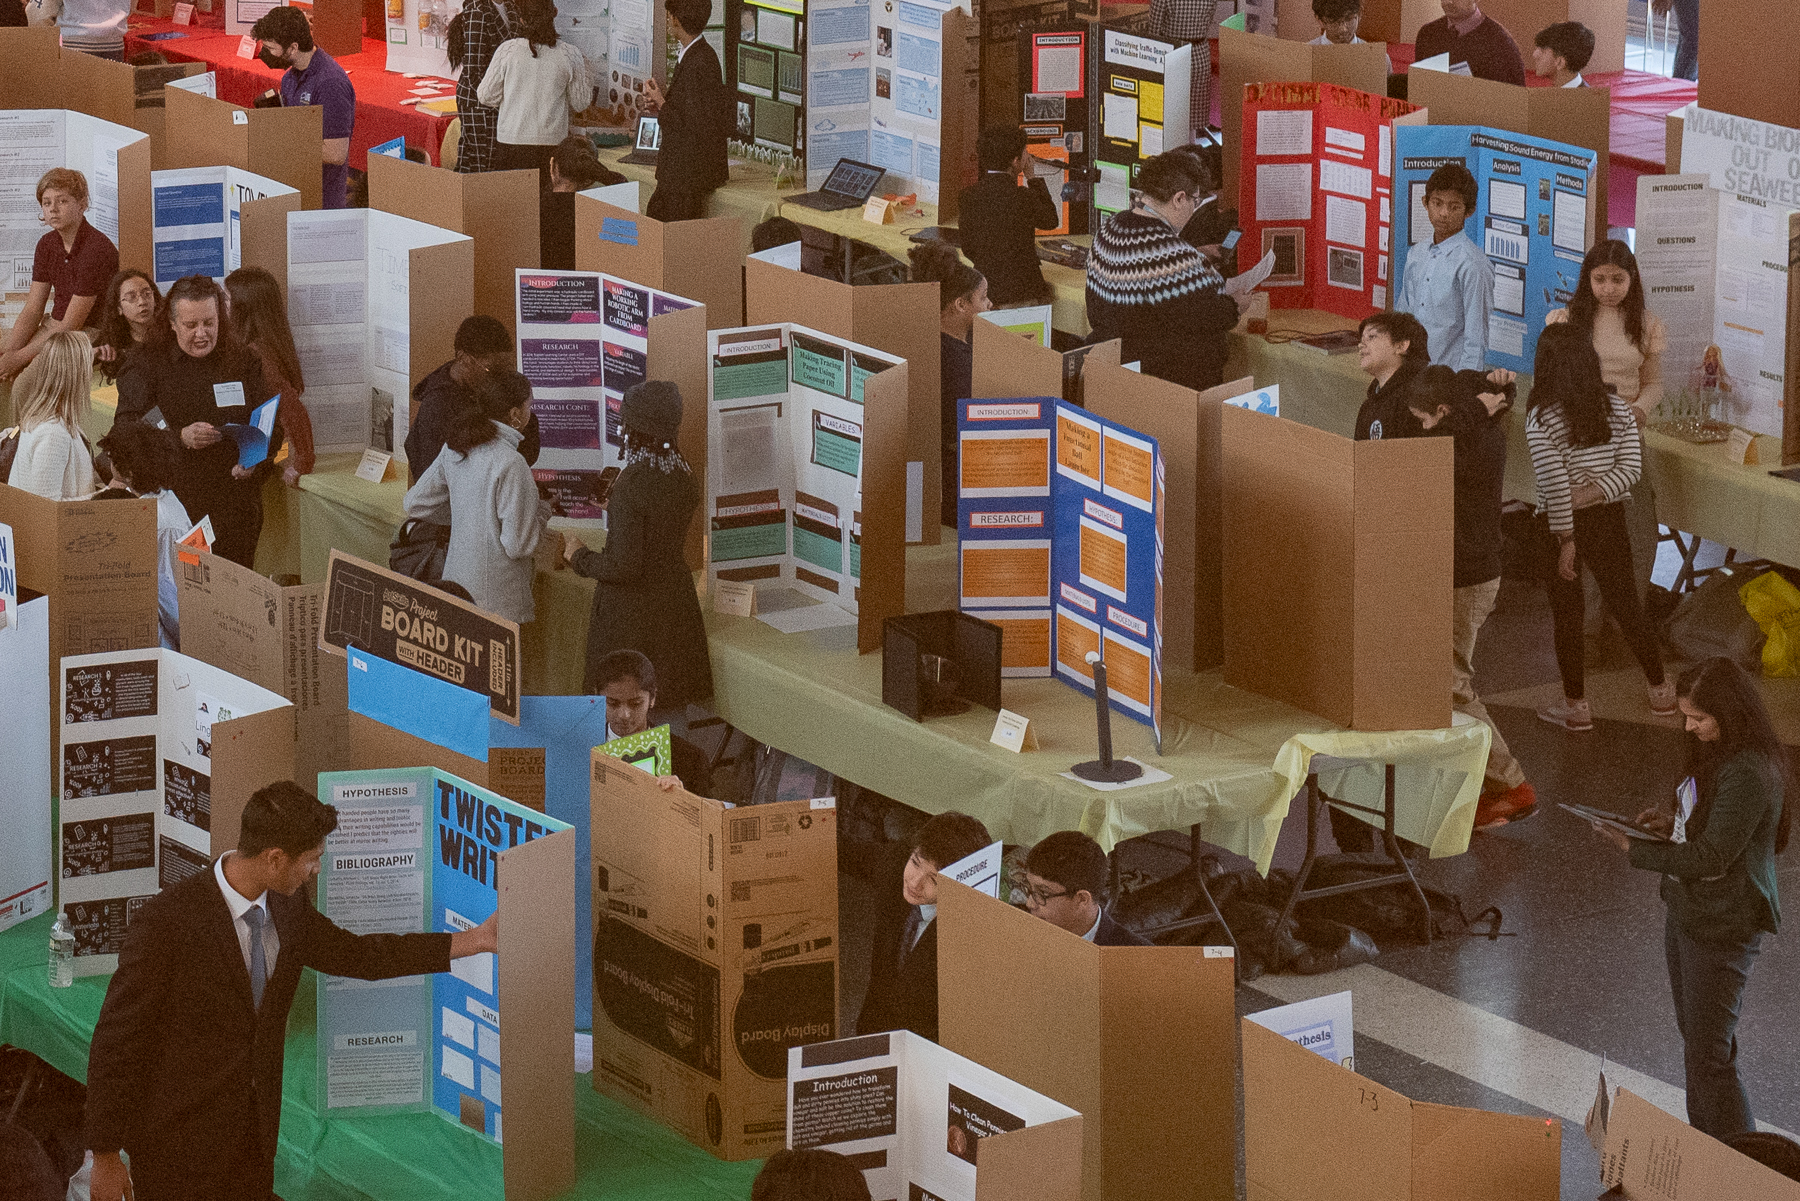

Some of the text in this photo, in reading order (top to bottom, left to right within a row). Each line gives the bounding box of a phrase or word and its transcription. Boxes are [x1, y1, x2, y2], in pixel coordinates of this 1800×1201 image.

[1115, 38, 1138, 51] Classifying
[1139, 52, 1157, 63] Learning
[1686, 107, 1759, 146] MAKING
[1472, 135, 1569, 163] Harvesting Sound Energy from
[1732, 145, 1770, 172] OUT
[1493, 161, 1520, 174] Analysis
[1557, 175, 1584, 188] Methods
[1652, 183, 1703, 192] INTRODUCTION
[1737, 194, 1767, 208] MATERIALS
[1657, 237, 1696, 245] QUESTIONS
[529, 279, 585, 288] INTRODUCTION
[1652, 285, 1695, 294] HYPOTHESIS
[611, 286, 632, 298] MAKING
[612, 294, 638, 307] WORKING
[607, 300, 630, 314] ROBOTIC
[631, 308, 643, 317] ARM
[617, 311, 633, 321] FROM
[609, 316, 641, 332] CARDBOARD
[800, 351, 841, 372] Making Tracing
[802, 364, 835, 379] Paper Using
[803, 373, 824, 385] Coconut
[1759, 370, 1782, 382] RESULTS
[538, 473, 581, 481] HYPOTHESIS
[410, 599, 438, 621] Project
[381, 605, 483, 667] BOARD KIT
[311, 627, 319, 679] Presentation
[399, 645, 464, 682] WITH HEADER
[342, 787, 408, 797] HYPOTHESIS
[436, 780, 555, 848] TWISTE
[336, 854, 414, 870] BIBLIOGRAPHY
[439, 823, 499, 889] WRIT
[482, 1009, 498, 1024] DATA
[347, 1035, 403, 1045] RESEARCH
[741, 1022, 830, 1044] Display Board
[813, 1074, 878, 1093] Introduction
[949, 1102, 986, 1127] How Clean
